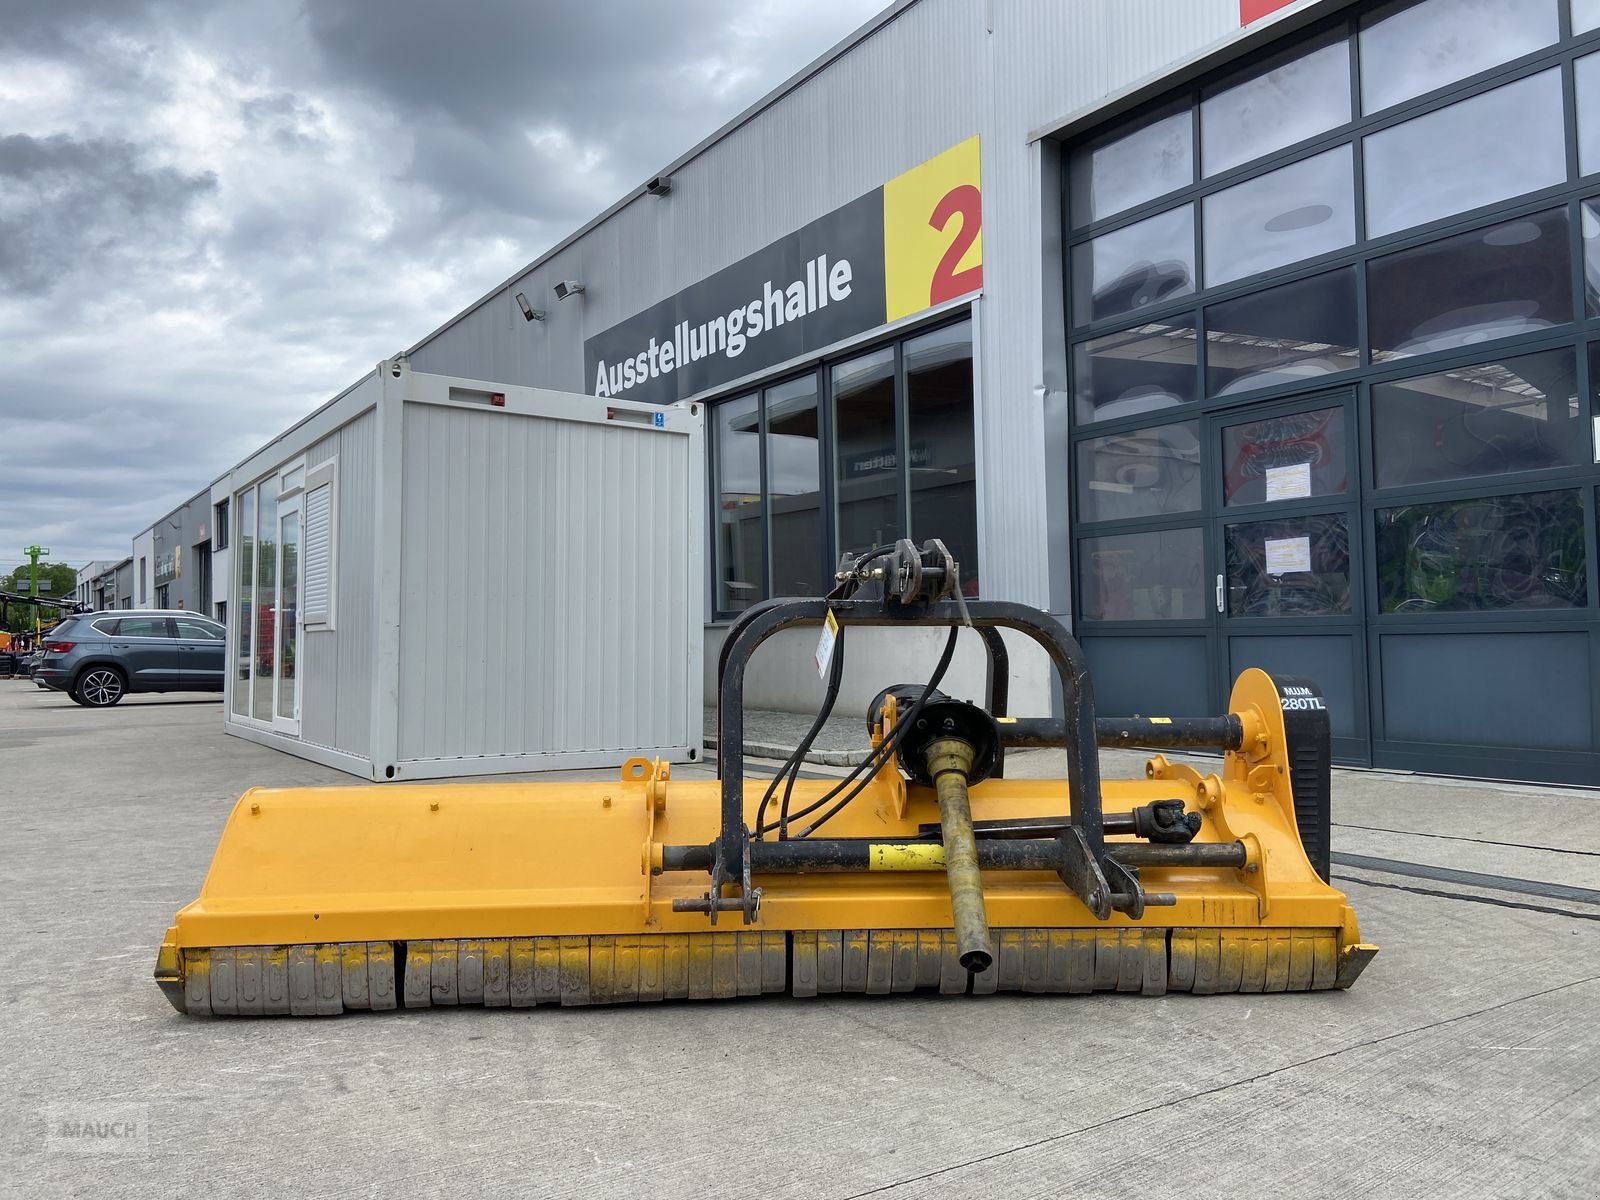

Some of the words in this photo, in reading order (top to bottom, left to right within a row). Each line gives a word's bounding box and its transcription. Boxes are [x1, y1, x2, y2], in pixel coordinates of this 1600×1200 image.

[594, 253, 853, 398] Ausstellungshalle
[928, 184, 984, 308] 2
[1281, 697, 1326, 710] 280TL
